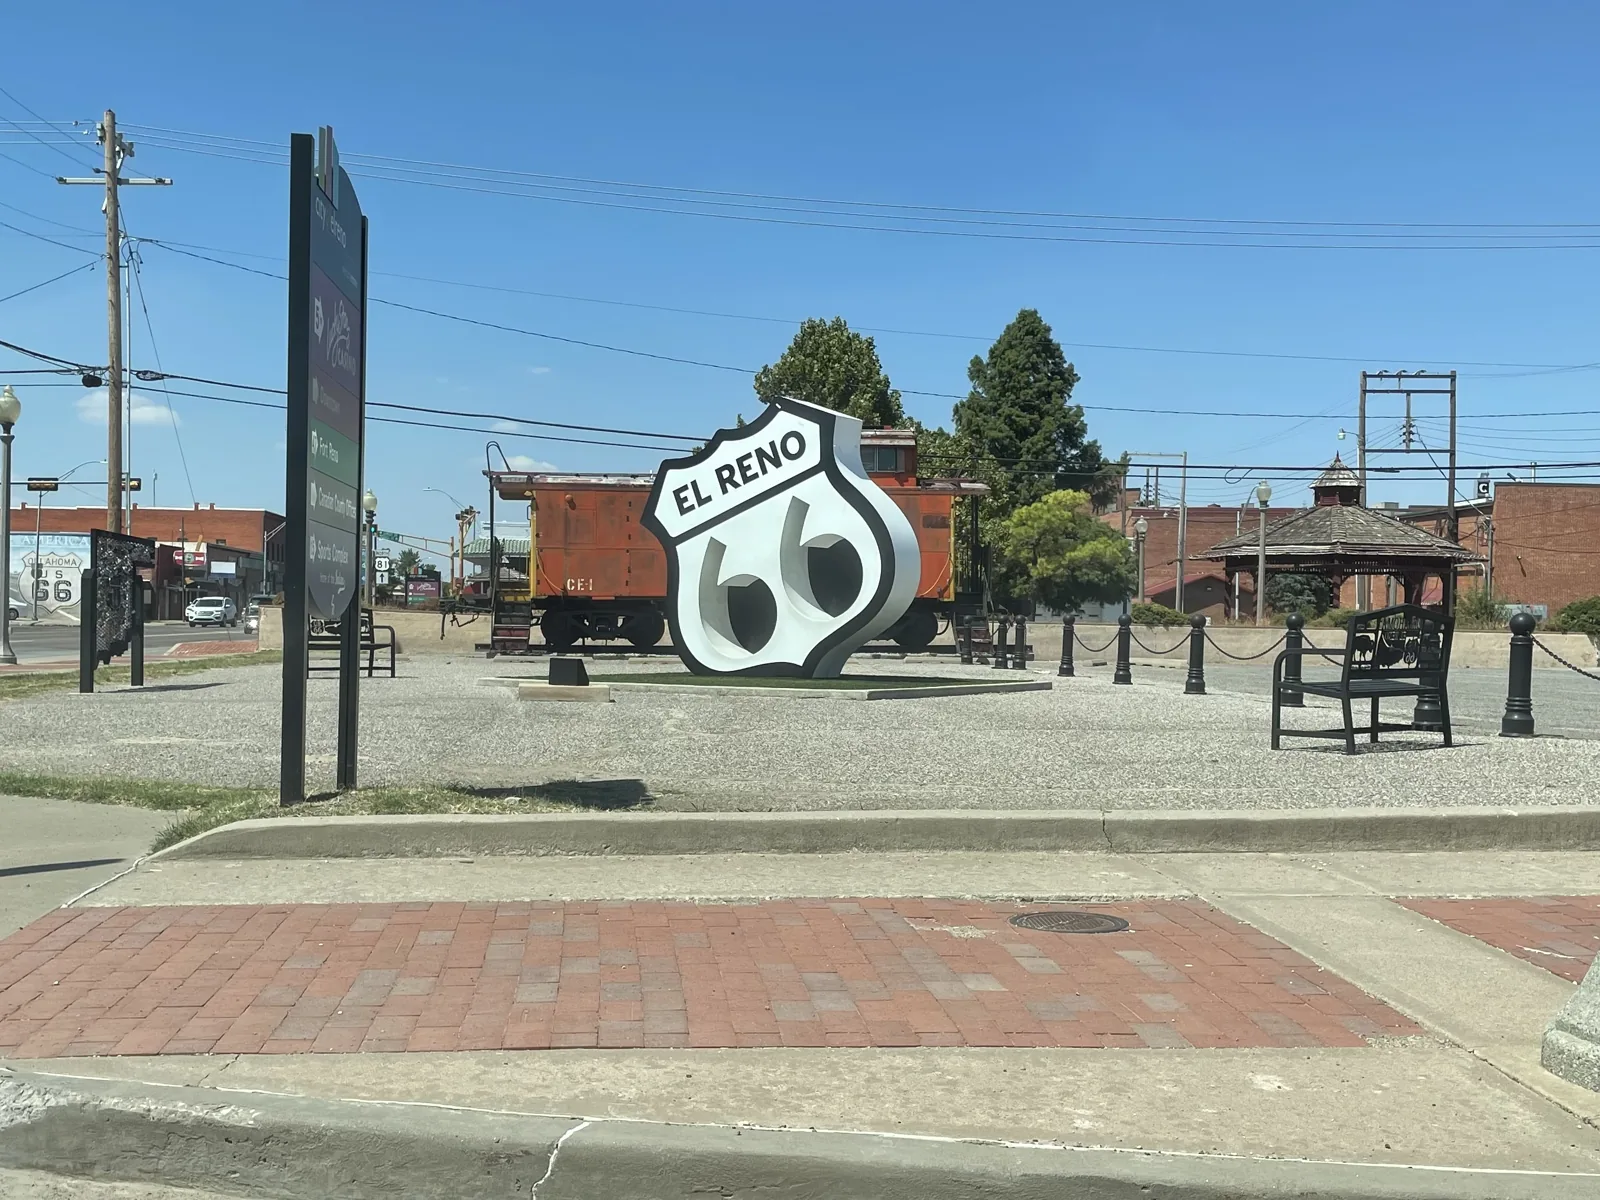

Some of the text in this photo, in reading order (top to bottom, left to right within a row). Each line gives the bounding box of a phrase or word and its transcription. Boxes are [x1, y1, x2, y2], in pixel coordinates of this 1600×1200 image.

[319, 436, 329, 459] Fort
[329, 442, 339, 464] Reno
[672, 430, 806, 516] EL RENO
[1478, 483, 1488, 493] C
[21, 536, 89, 547] AMERICA
[317, 539, 331, 562] Sports
[331, 543, 349, 566] Complex
[27, 557, 77, 567] OLAHOMA
[377, 560, 388, 569] 81
[698, 495, 864, 659] 66
[32, 579, 72, 602] 66
